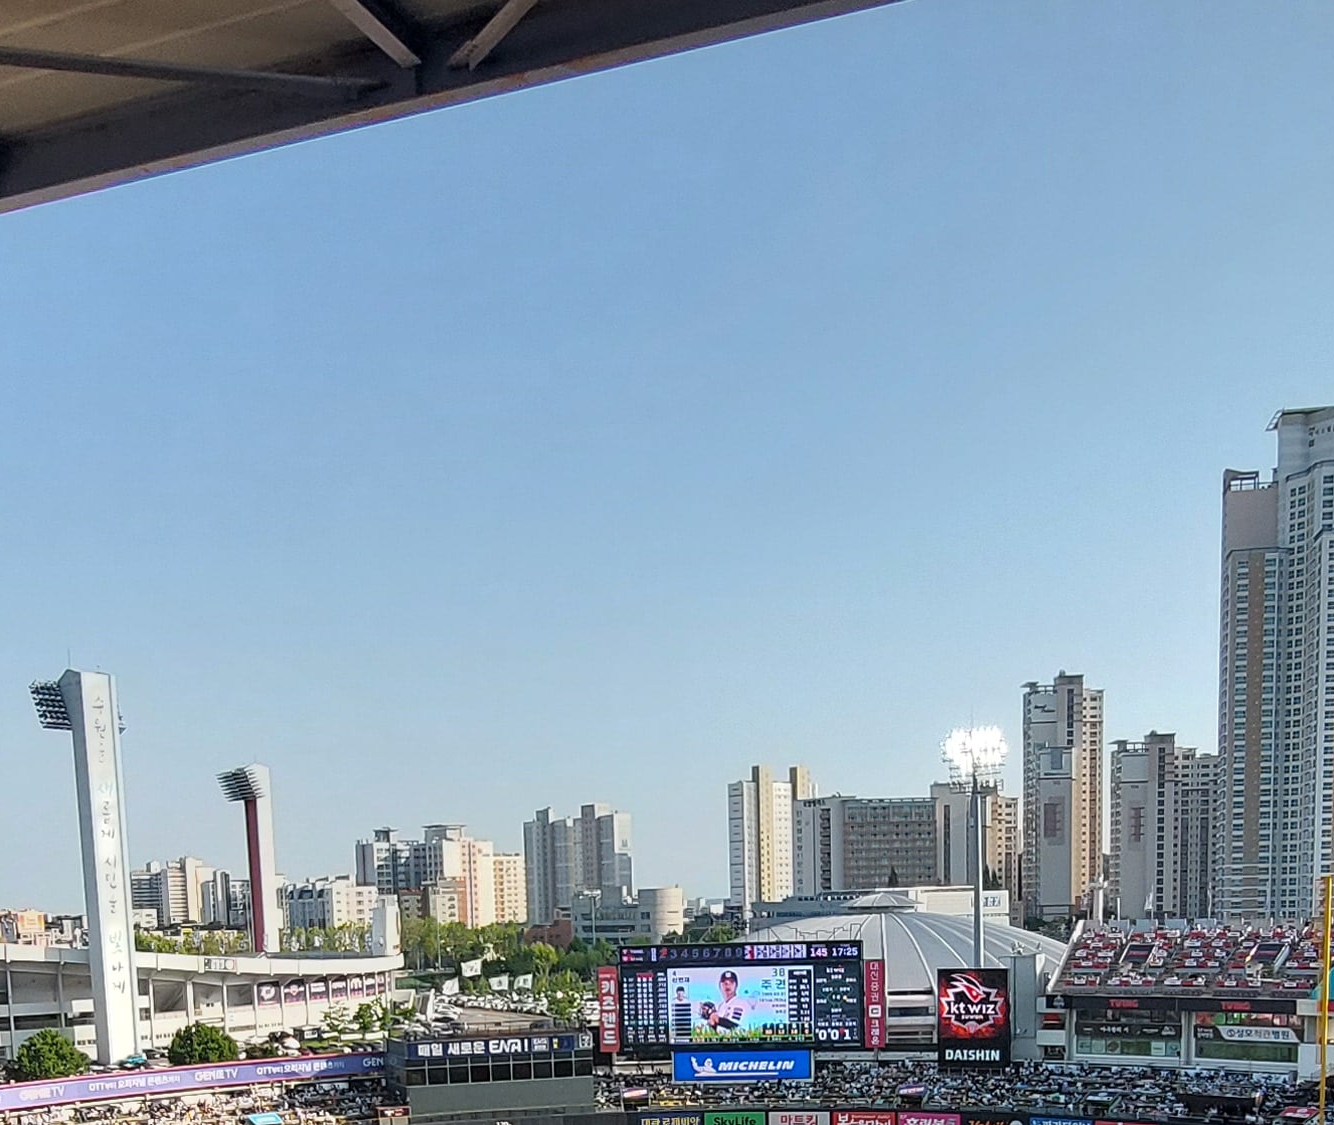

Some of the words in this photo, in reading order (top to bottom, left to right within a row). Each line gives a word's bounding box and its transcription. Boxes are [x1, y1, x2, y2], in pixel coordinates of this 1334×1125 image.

[810, 948, 827, 957] 145
[832, 947, 858, 956] 17:25
[601, 980, 617, 1045] 키즈랜드
[951, 1002, 965, 1014] kt
[968, 1004, 995, 1014] wiz
[447, 1042, 485, 1055] 새로운
[945, 1049, 1000, 1061] DAISHIN
[718, 1060, 795, 1072] MICHELIN
[225, 1069, 238, 1080] TV
[51, 1086, 65, 1097] TV
